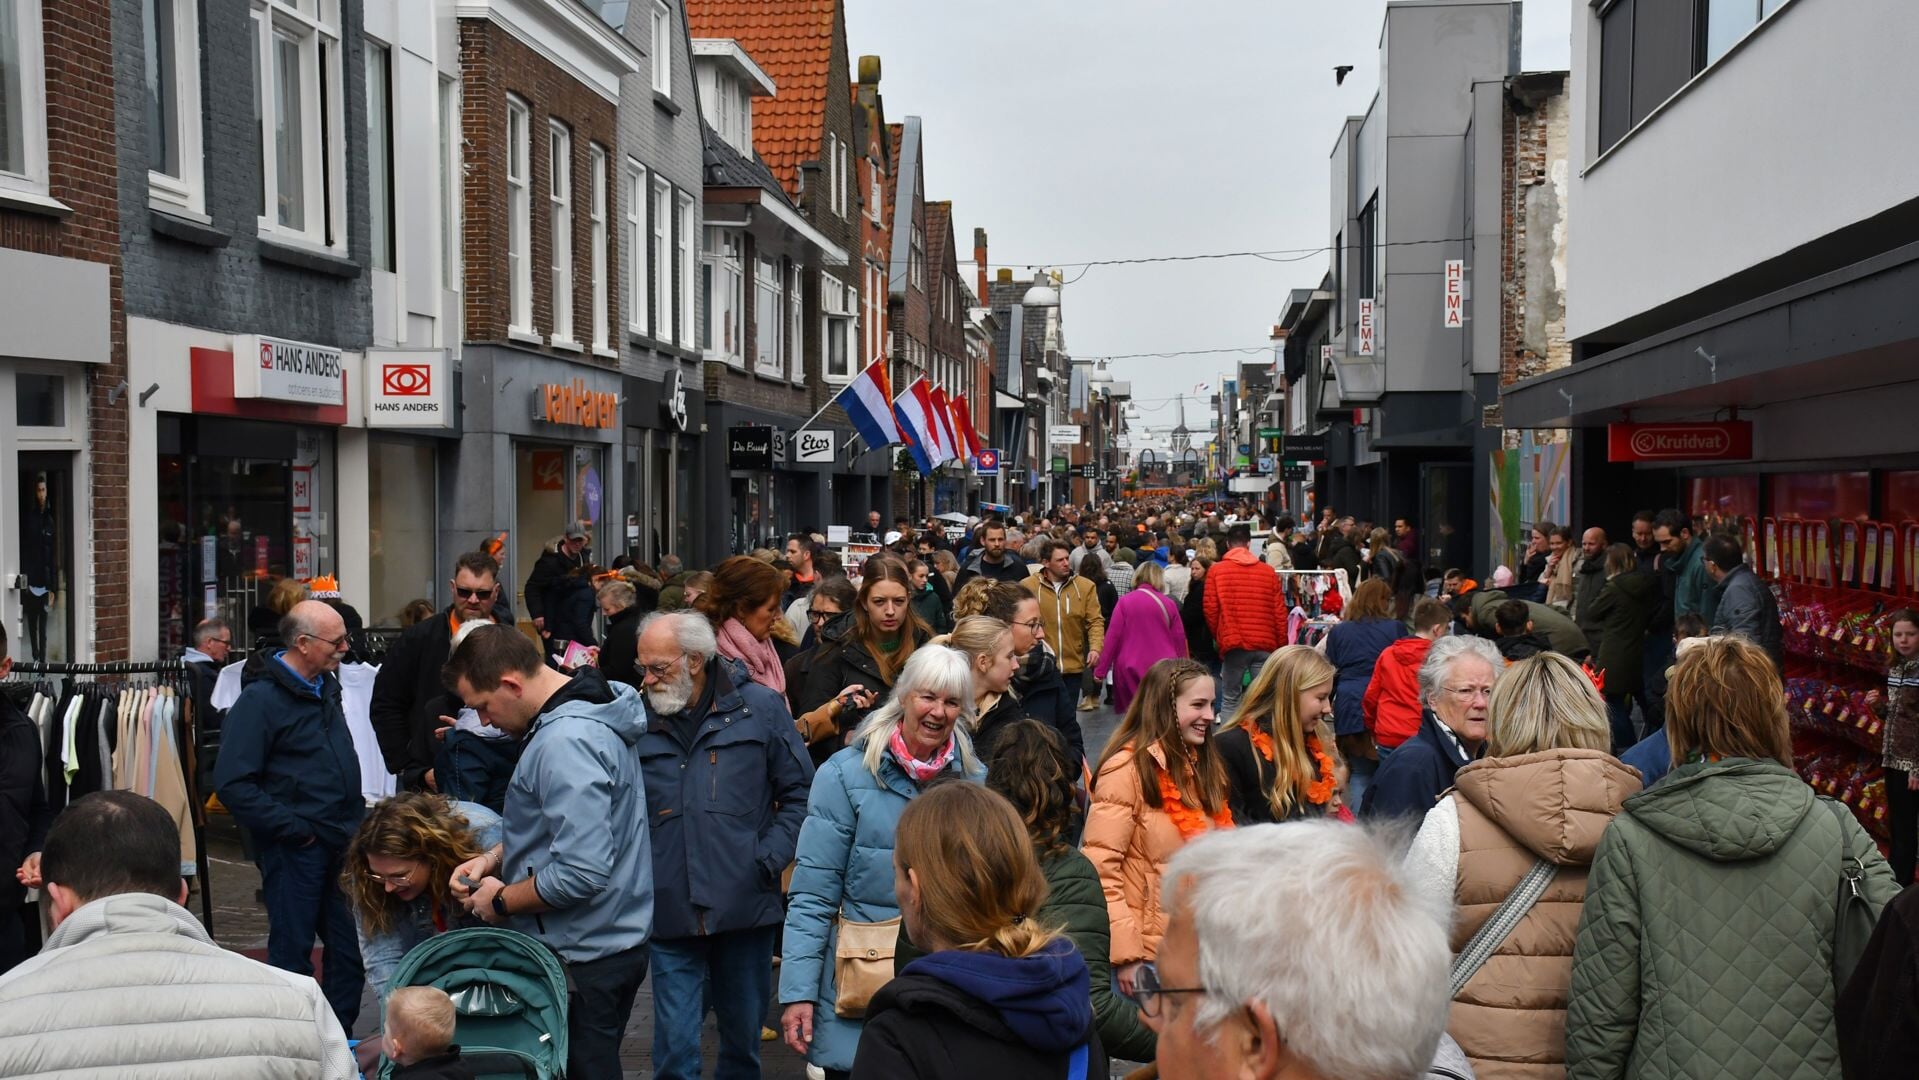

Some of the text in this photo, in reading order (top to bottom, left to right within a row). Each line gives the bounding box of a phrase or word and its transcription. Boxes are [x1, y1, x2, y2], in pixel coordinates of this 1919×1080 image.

[1447, 263, 1460, 324] HEMA
[1361, 302, 1372, 353] HEMA
[276, 345, 340, 378] HANS ANDERS
[374, 403, 439, 412] HANS ANDERS
[544, 377, 618, 430] vanHaren
[801, 434, 830, 450] Etos
[1656, 434, 1722, 449] Kruidvat
